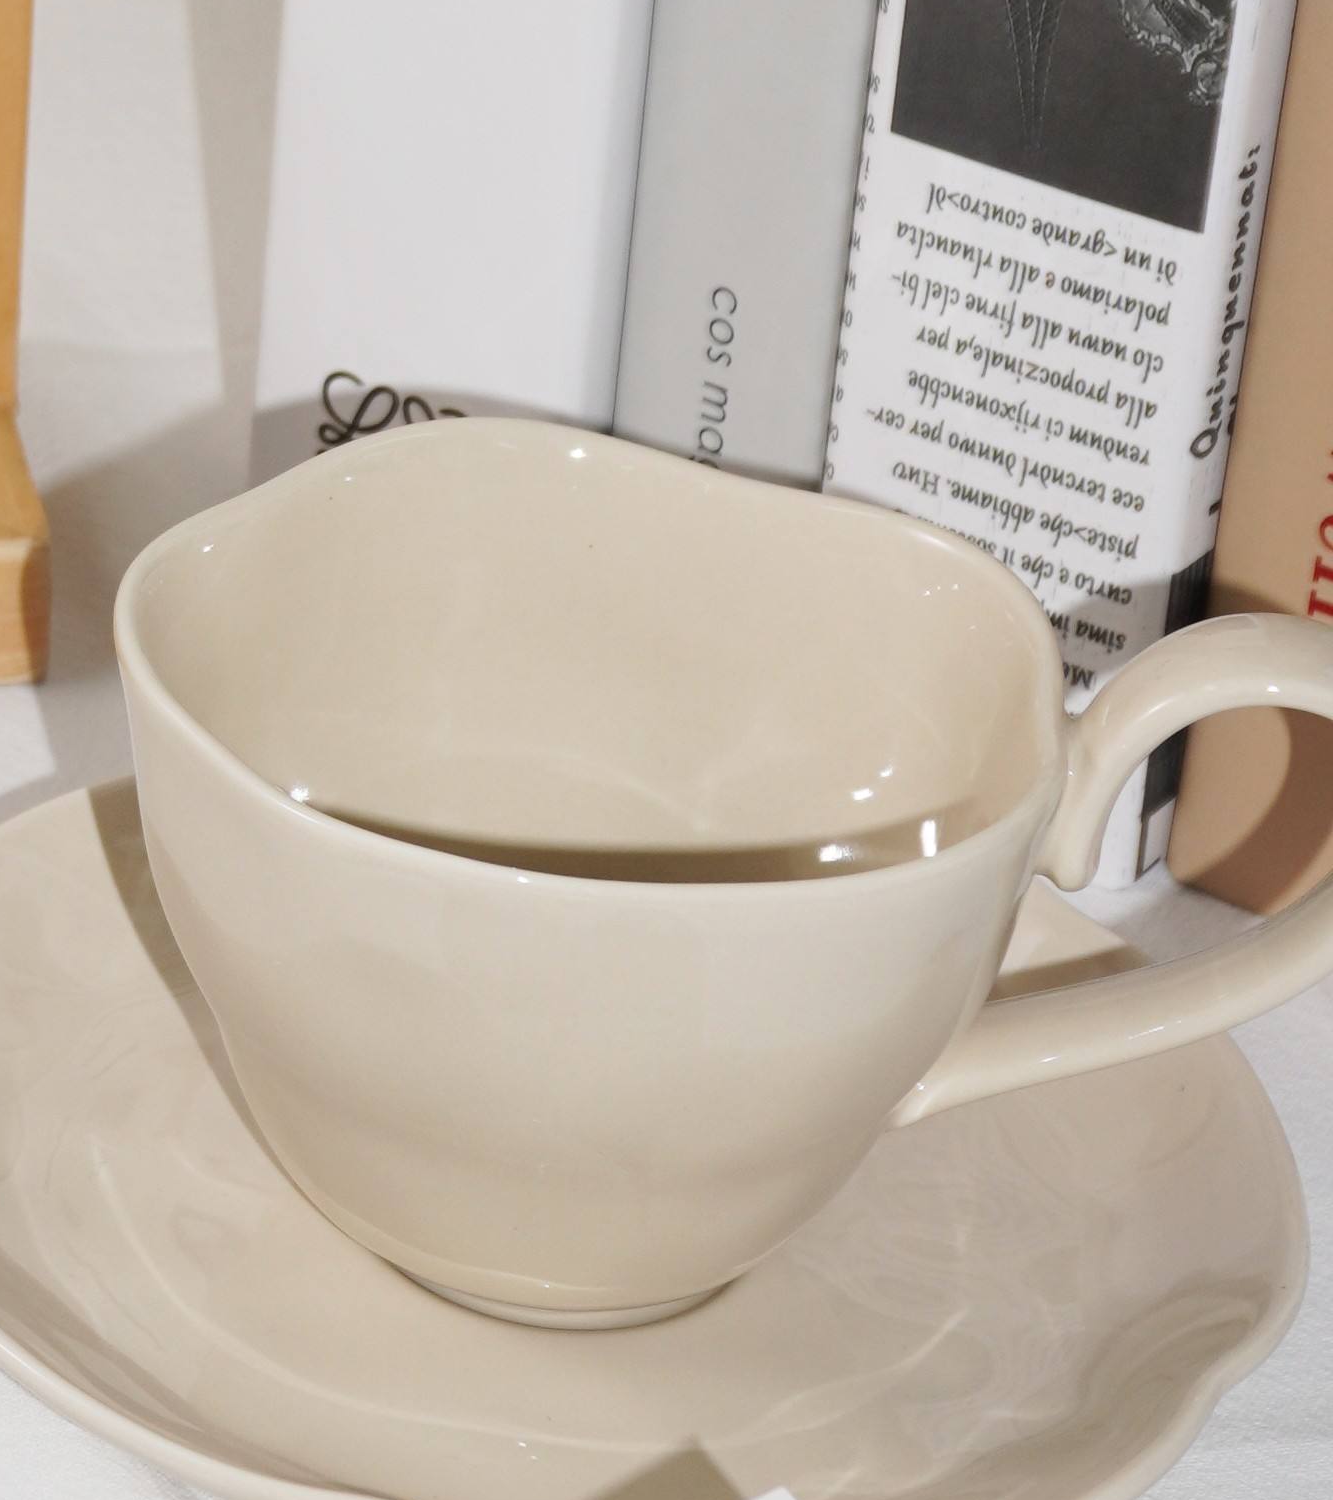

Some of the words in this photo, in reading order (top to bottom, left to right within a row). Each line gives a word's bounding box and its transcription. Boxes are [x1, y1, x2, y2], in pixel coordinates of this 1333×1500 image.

[1123, 246, 1152, 272] un
[1156, 257, 1178, 287] di
[998, 255, 1041, 295] alla
[1044, 271, 1056, 289] e
[704, 285, 738, 368] cos
[915, 325, 951, 351] per
[1020, 311, 1063, 351] alla
[1114, 391, 1158, 430] alla
[908, 419, 945, 444] per
[1111, 487, 1145, 513] ece
[1017, 554, 1055, 589] che
[1058, 567, 1070, 585] e
[1074, 572, 1133, 605] curto
